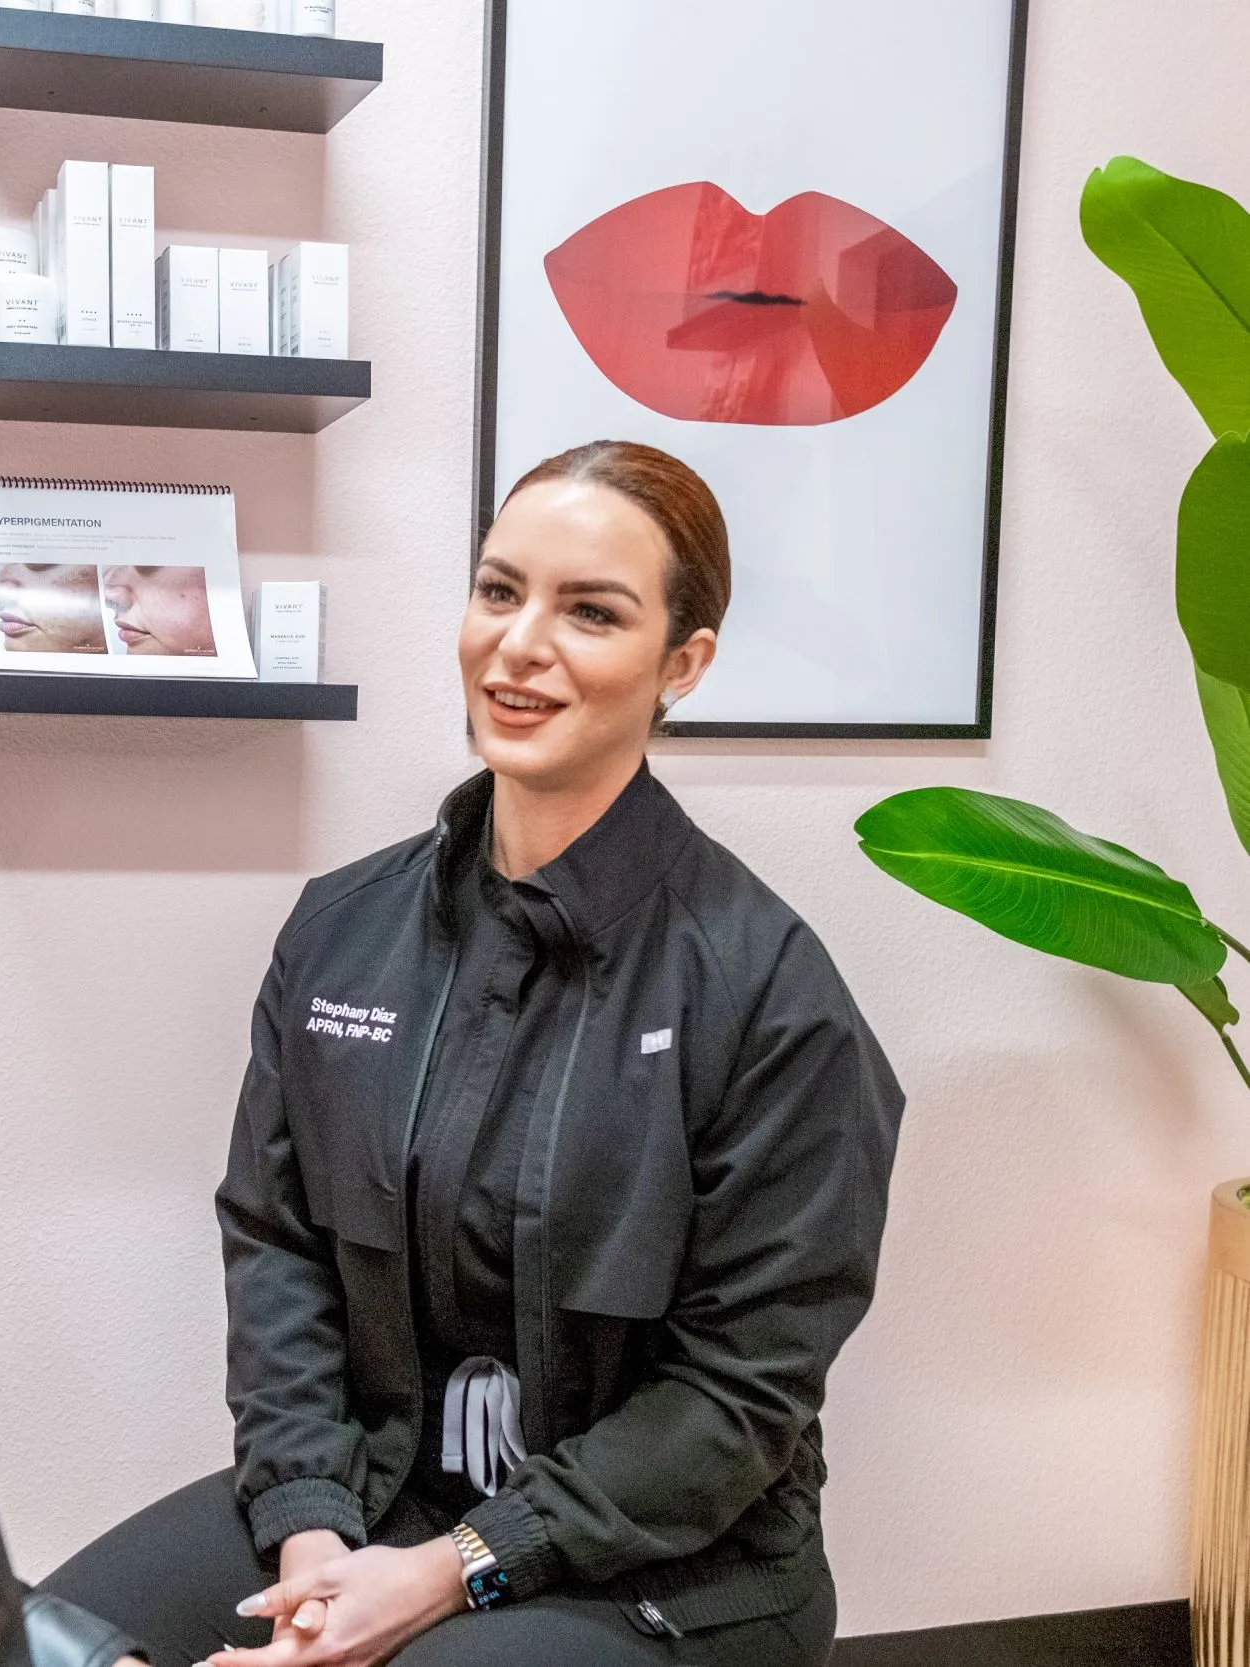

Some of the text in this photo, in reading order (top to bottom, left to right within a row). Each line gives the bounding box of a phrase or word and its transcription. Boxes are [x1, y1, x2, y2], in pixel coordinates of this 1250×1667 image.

[5, 299, 38, 307] VIVANT
[311, 997, 397, 1024] Stephany Diaz
[306, 1017, 393, 1042] APRN, FNP-BC
